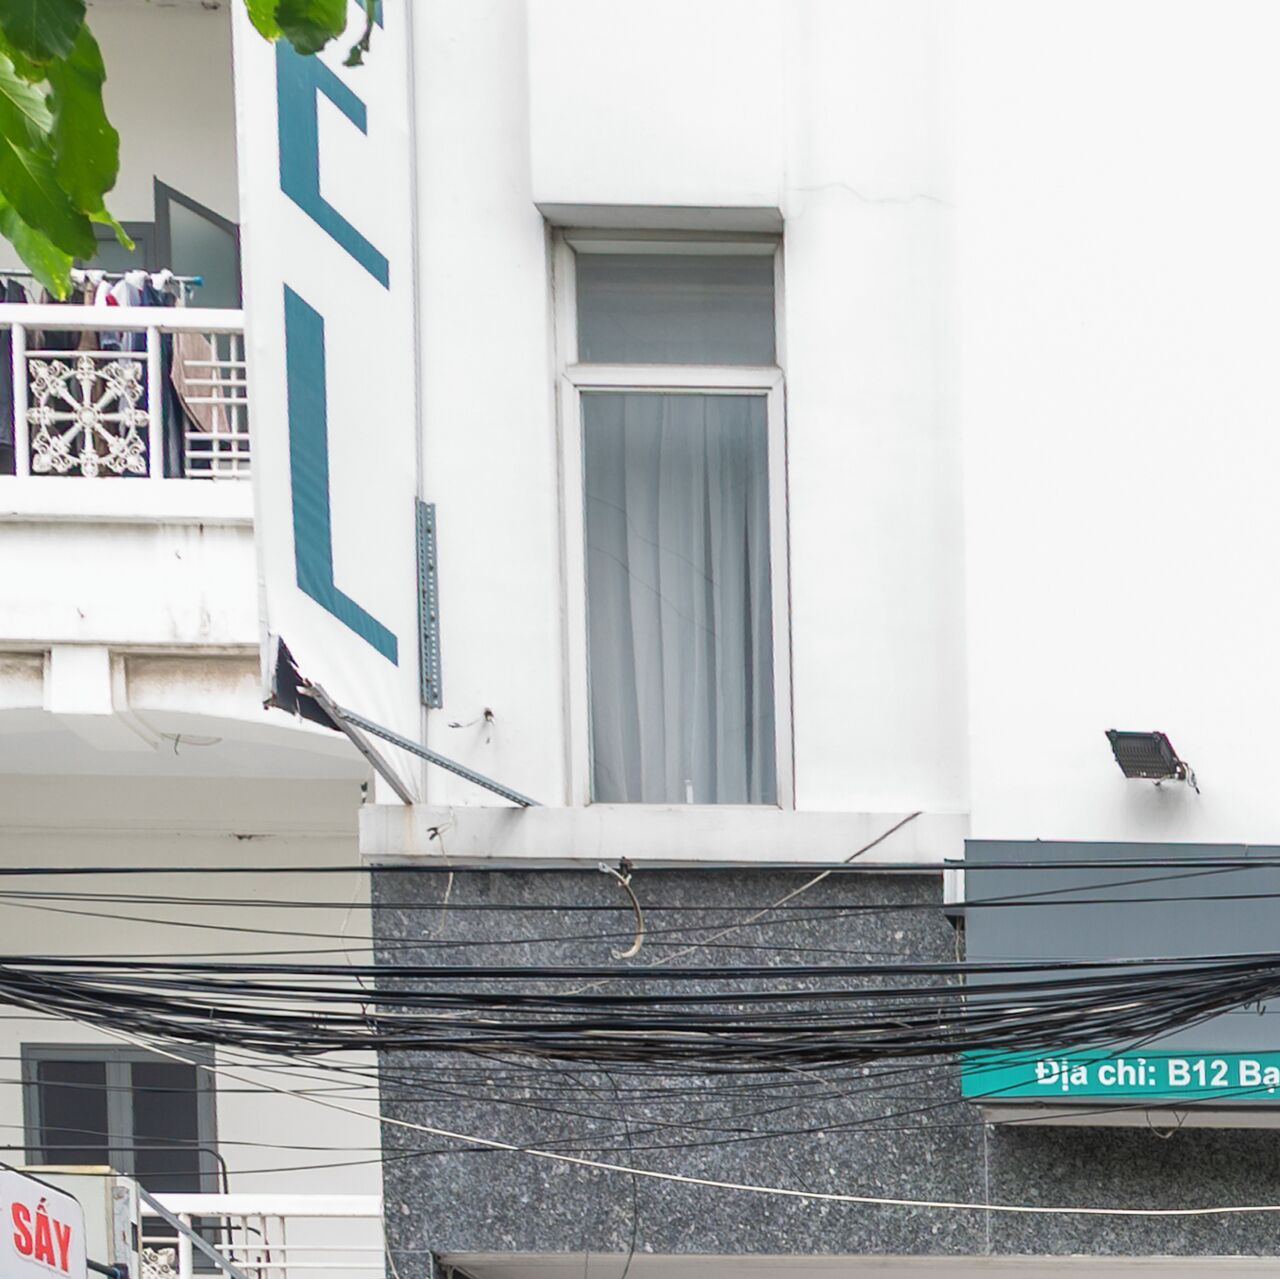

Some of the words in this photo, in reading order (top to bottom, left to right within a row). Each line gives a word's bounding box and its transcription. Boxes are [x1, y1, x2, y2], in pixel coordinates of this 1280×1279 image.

[1035, 1057, 1090, 1092] Địa
[1097, 1056, 1156, 1087] chỉ:
[1168, 1059, 1228, 1087] B12
[11, 1197, 72, 1273] SẤY
